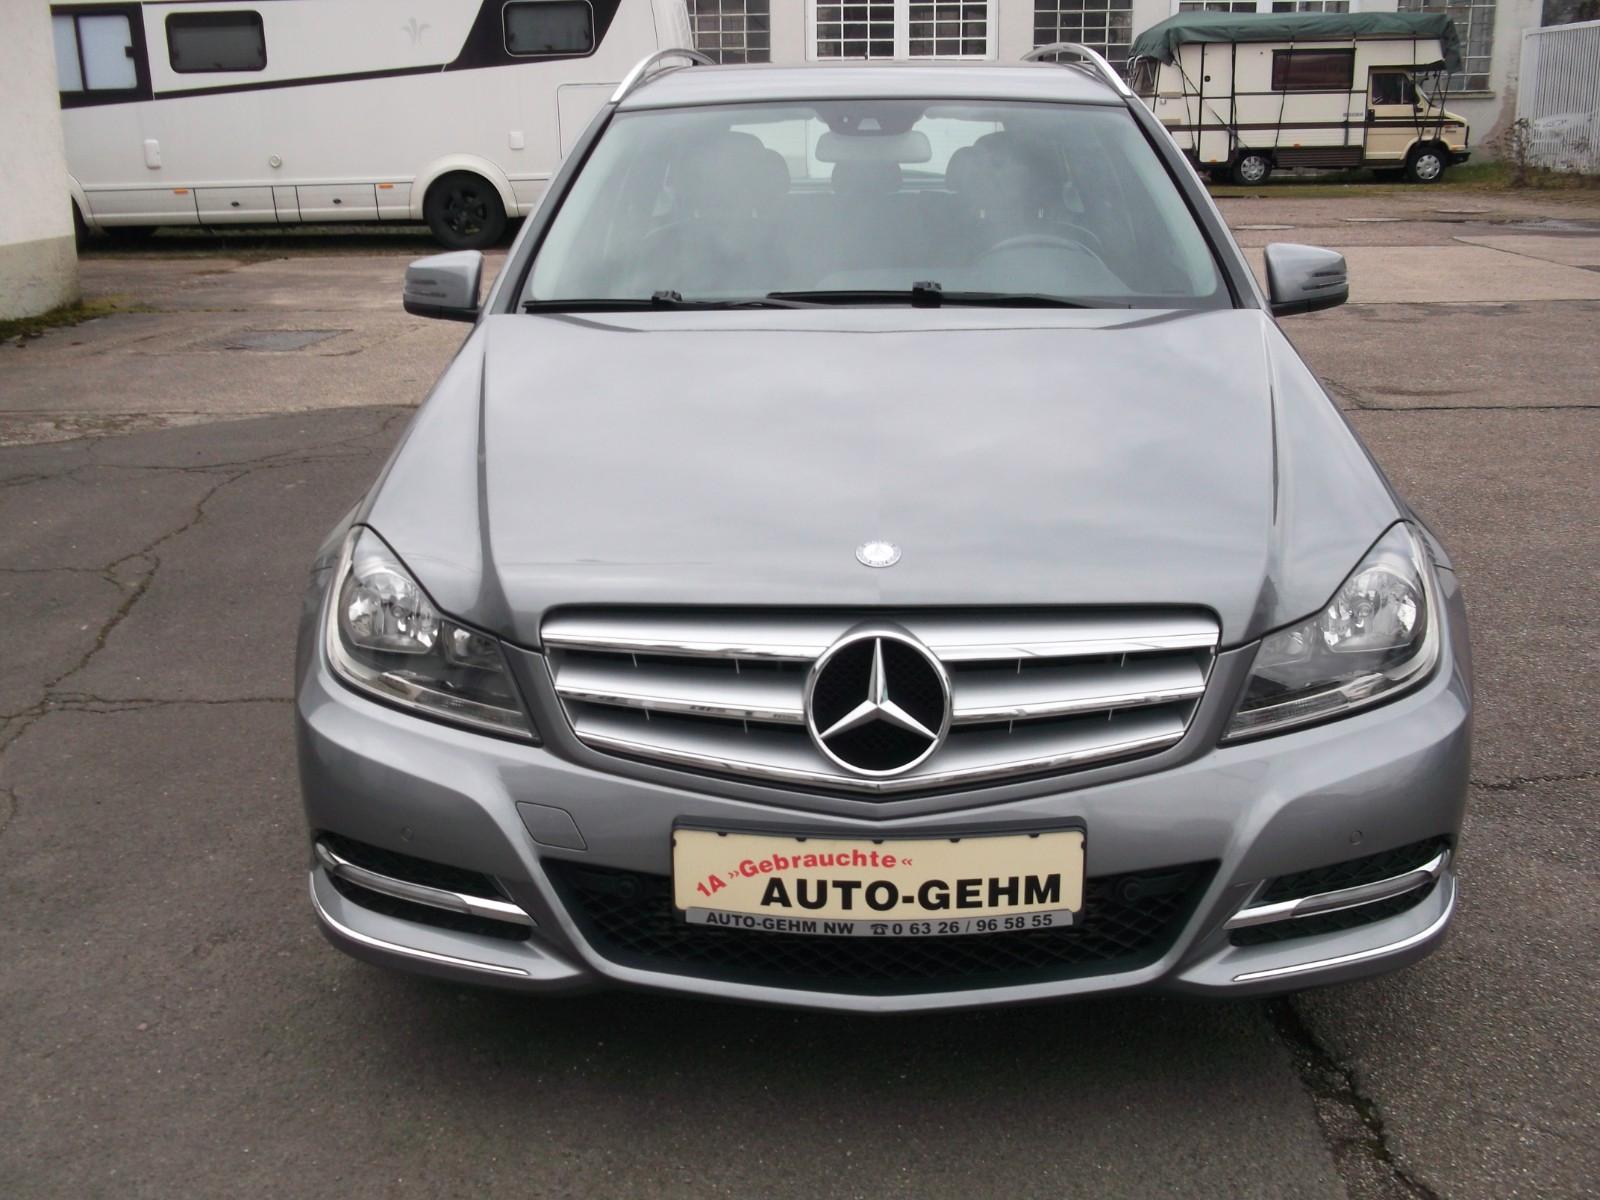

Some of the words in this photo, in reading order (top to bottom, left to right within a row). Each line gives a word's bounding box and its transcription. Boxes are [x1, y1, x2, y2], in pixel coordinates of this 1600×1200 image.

[696, 874, 727, 897] 1A
[760, 873, 1061, 912] AUTO-GEHM
[706, 911, 817, 933] AUTO-GEHM
[823, 922, 854, 935] NW
[909, 922, 931, 935] 63
[938, 921, 960, 934] 26
[976, 919, 998, 932] 96
[1004, 916, 1025, 930] 58
[1031, 913, 1053, 927] 55
